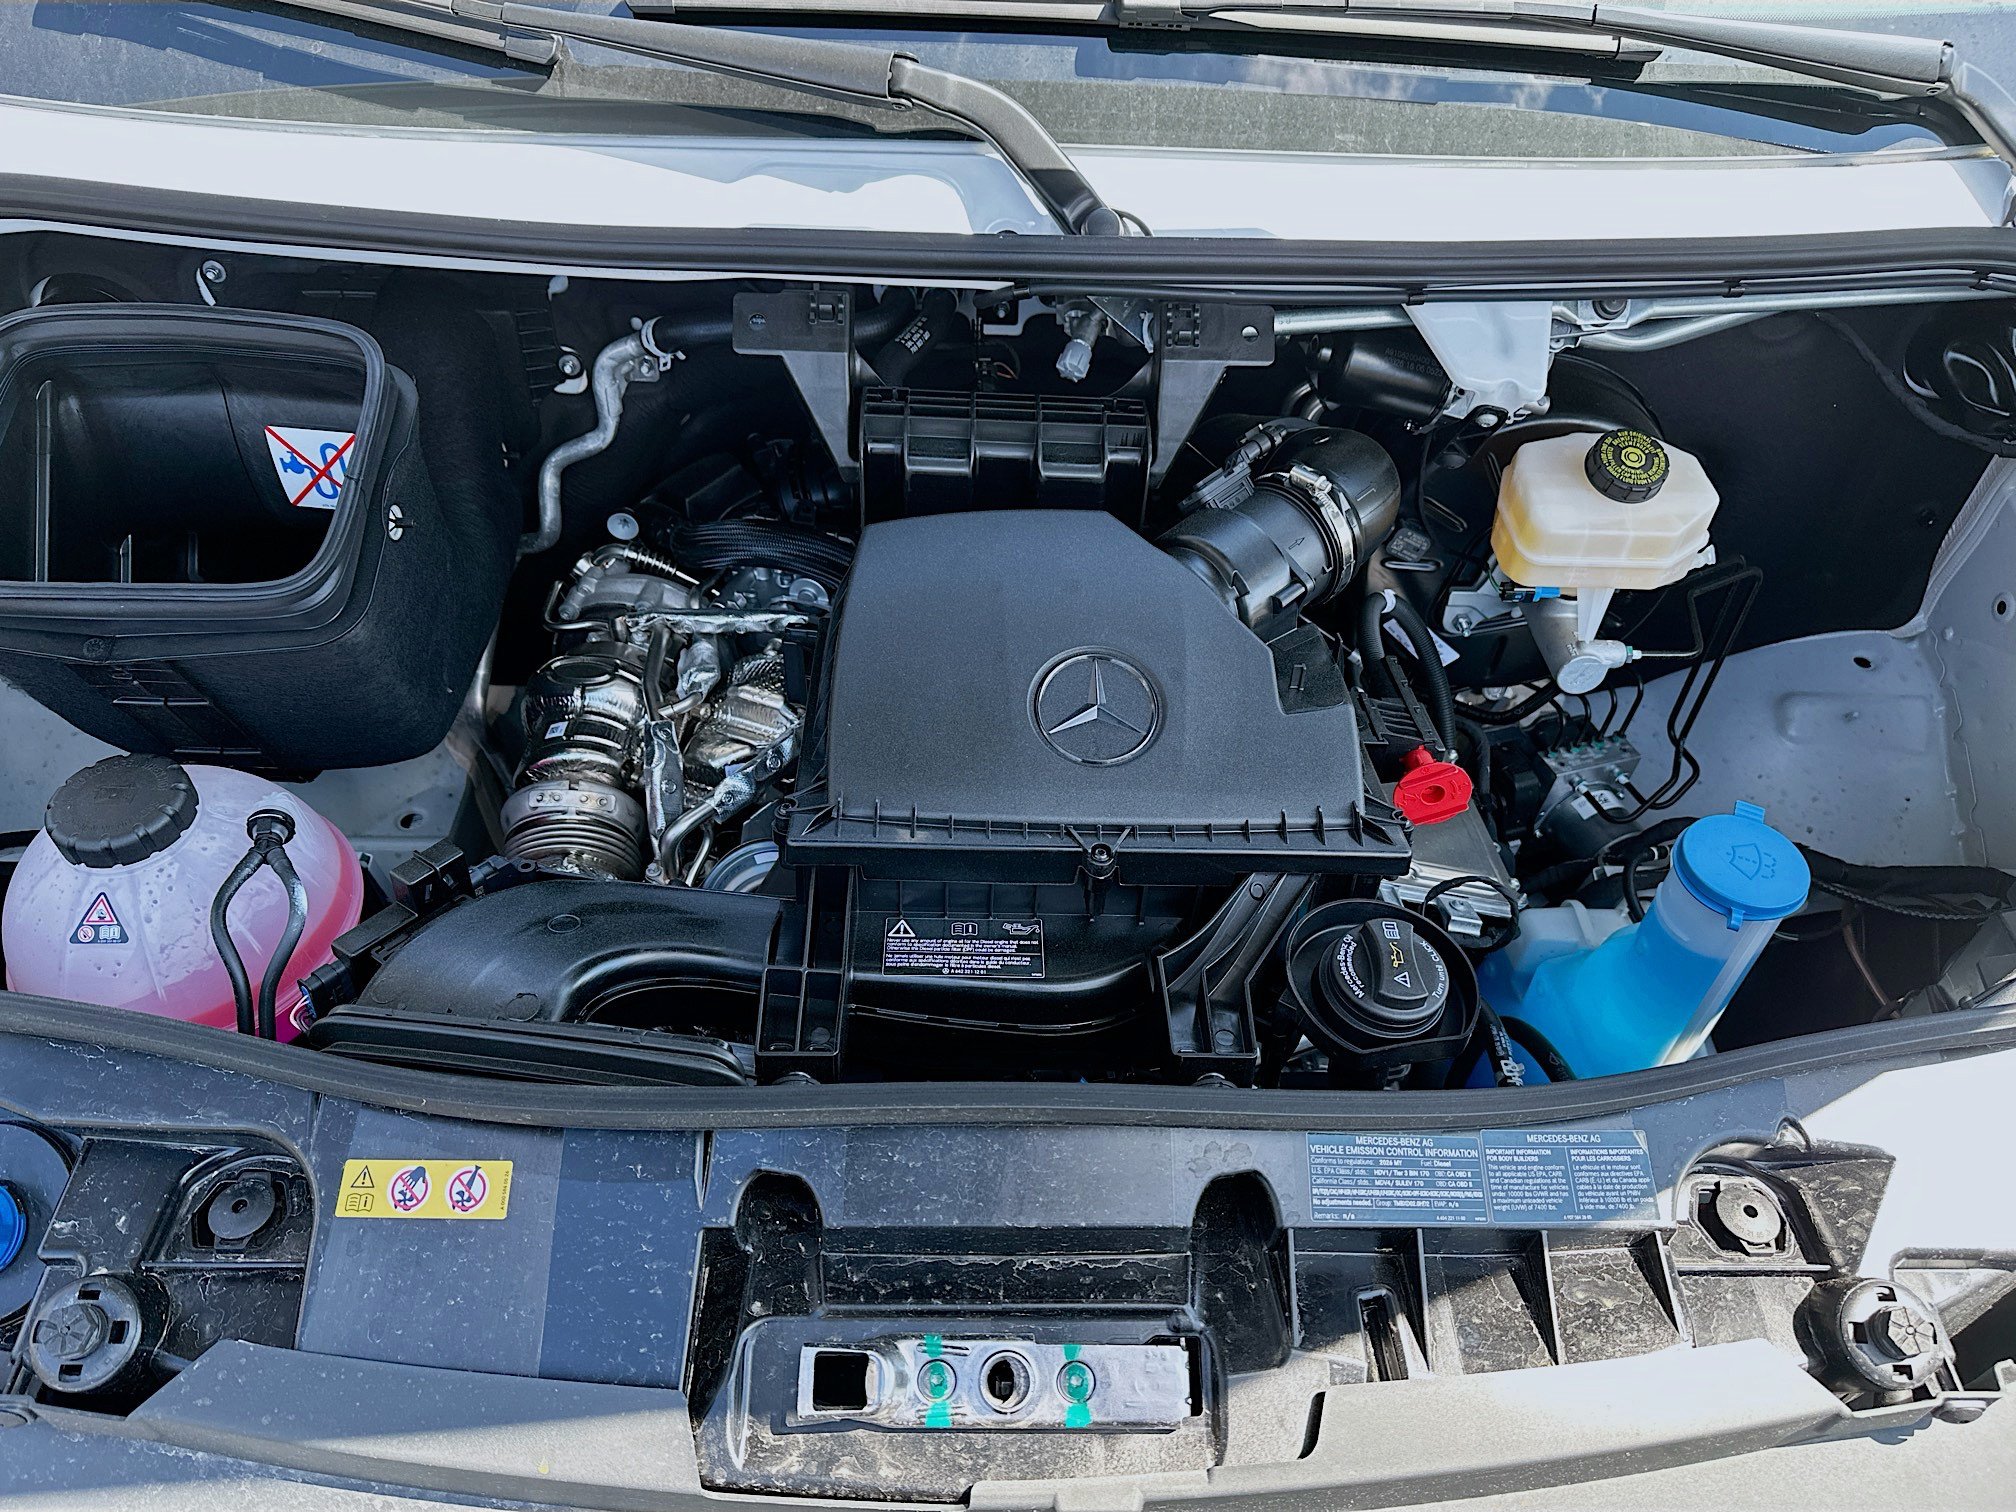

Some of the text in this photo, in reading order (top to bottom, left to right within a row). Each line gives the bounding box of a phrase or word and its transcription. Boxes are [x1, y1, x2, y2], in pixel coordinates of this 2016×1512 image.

[1337, 933, 1365, 999] Mercedes-Benz Oil
[1346, 942, 1365, 988] recommended
[1420, 940, 1445, 999] Turn until CLICK
[1310, 1144, 1478, 1158] VEHICLE EMISSION CONTROL INFORMATION
[1355, 1136, 1434, 1148] MERCEDES-BENZ AG
[1526, 1134, 1601, 1143] MERCEDES-BENZ AG
